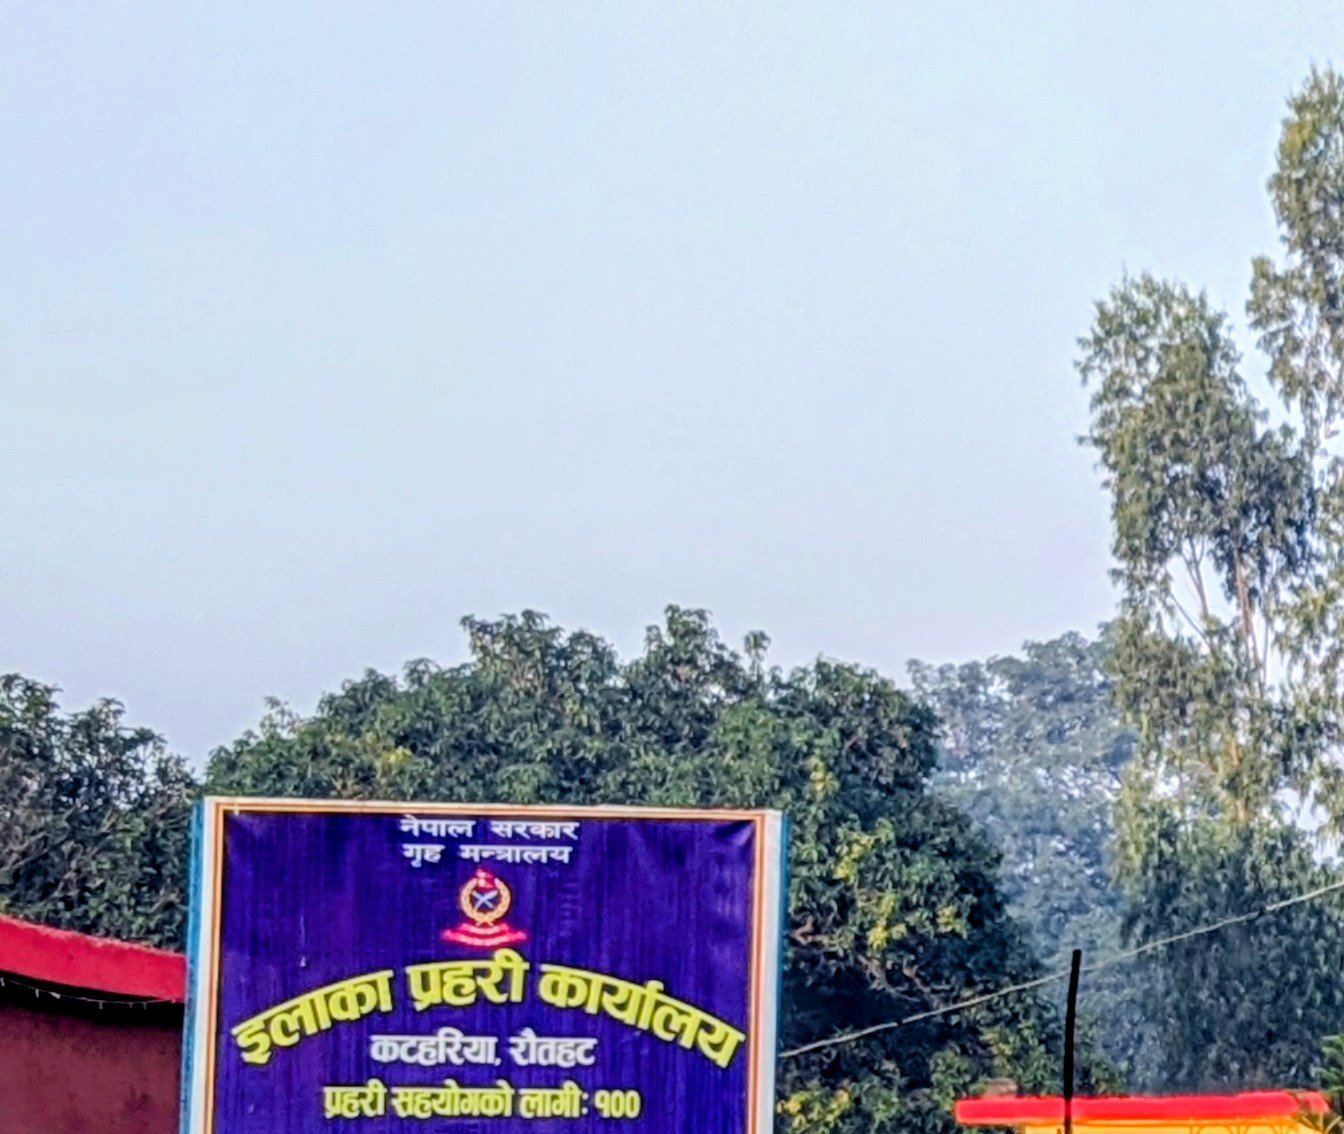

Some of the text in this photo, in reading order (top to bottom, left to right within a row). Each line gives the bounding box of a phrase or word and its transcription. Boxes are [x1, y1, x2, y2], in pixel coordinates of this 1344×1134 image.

[400, 814, 580, 839] नेपाल सरकार
[402, 843, 573, 868] गृह मन्त्रालय
[231, 948, 746, 1068] इलाका प्रहरी कार्यालय
[370, 1027, 598, 1068] कटहरिया, रौतहट
[323, 1078, 387, 1118] प्रहरी
[391, 1078, 515, 1118] सहयोगको
